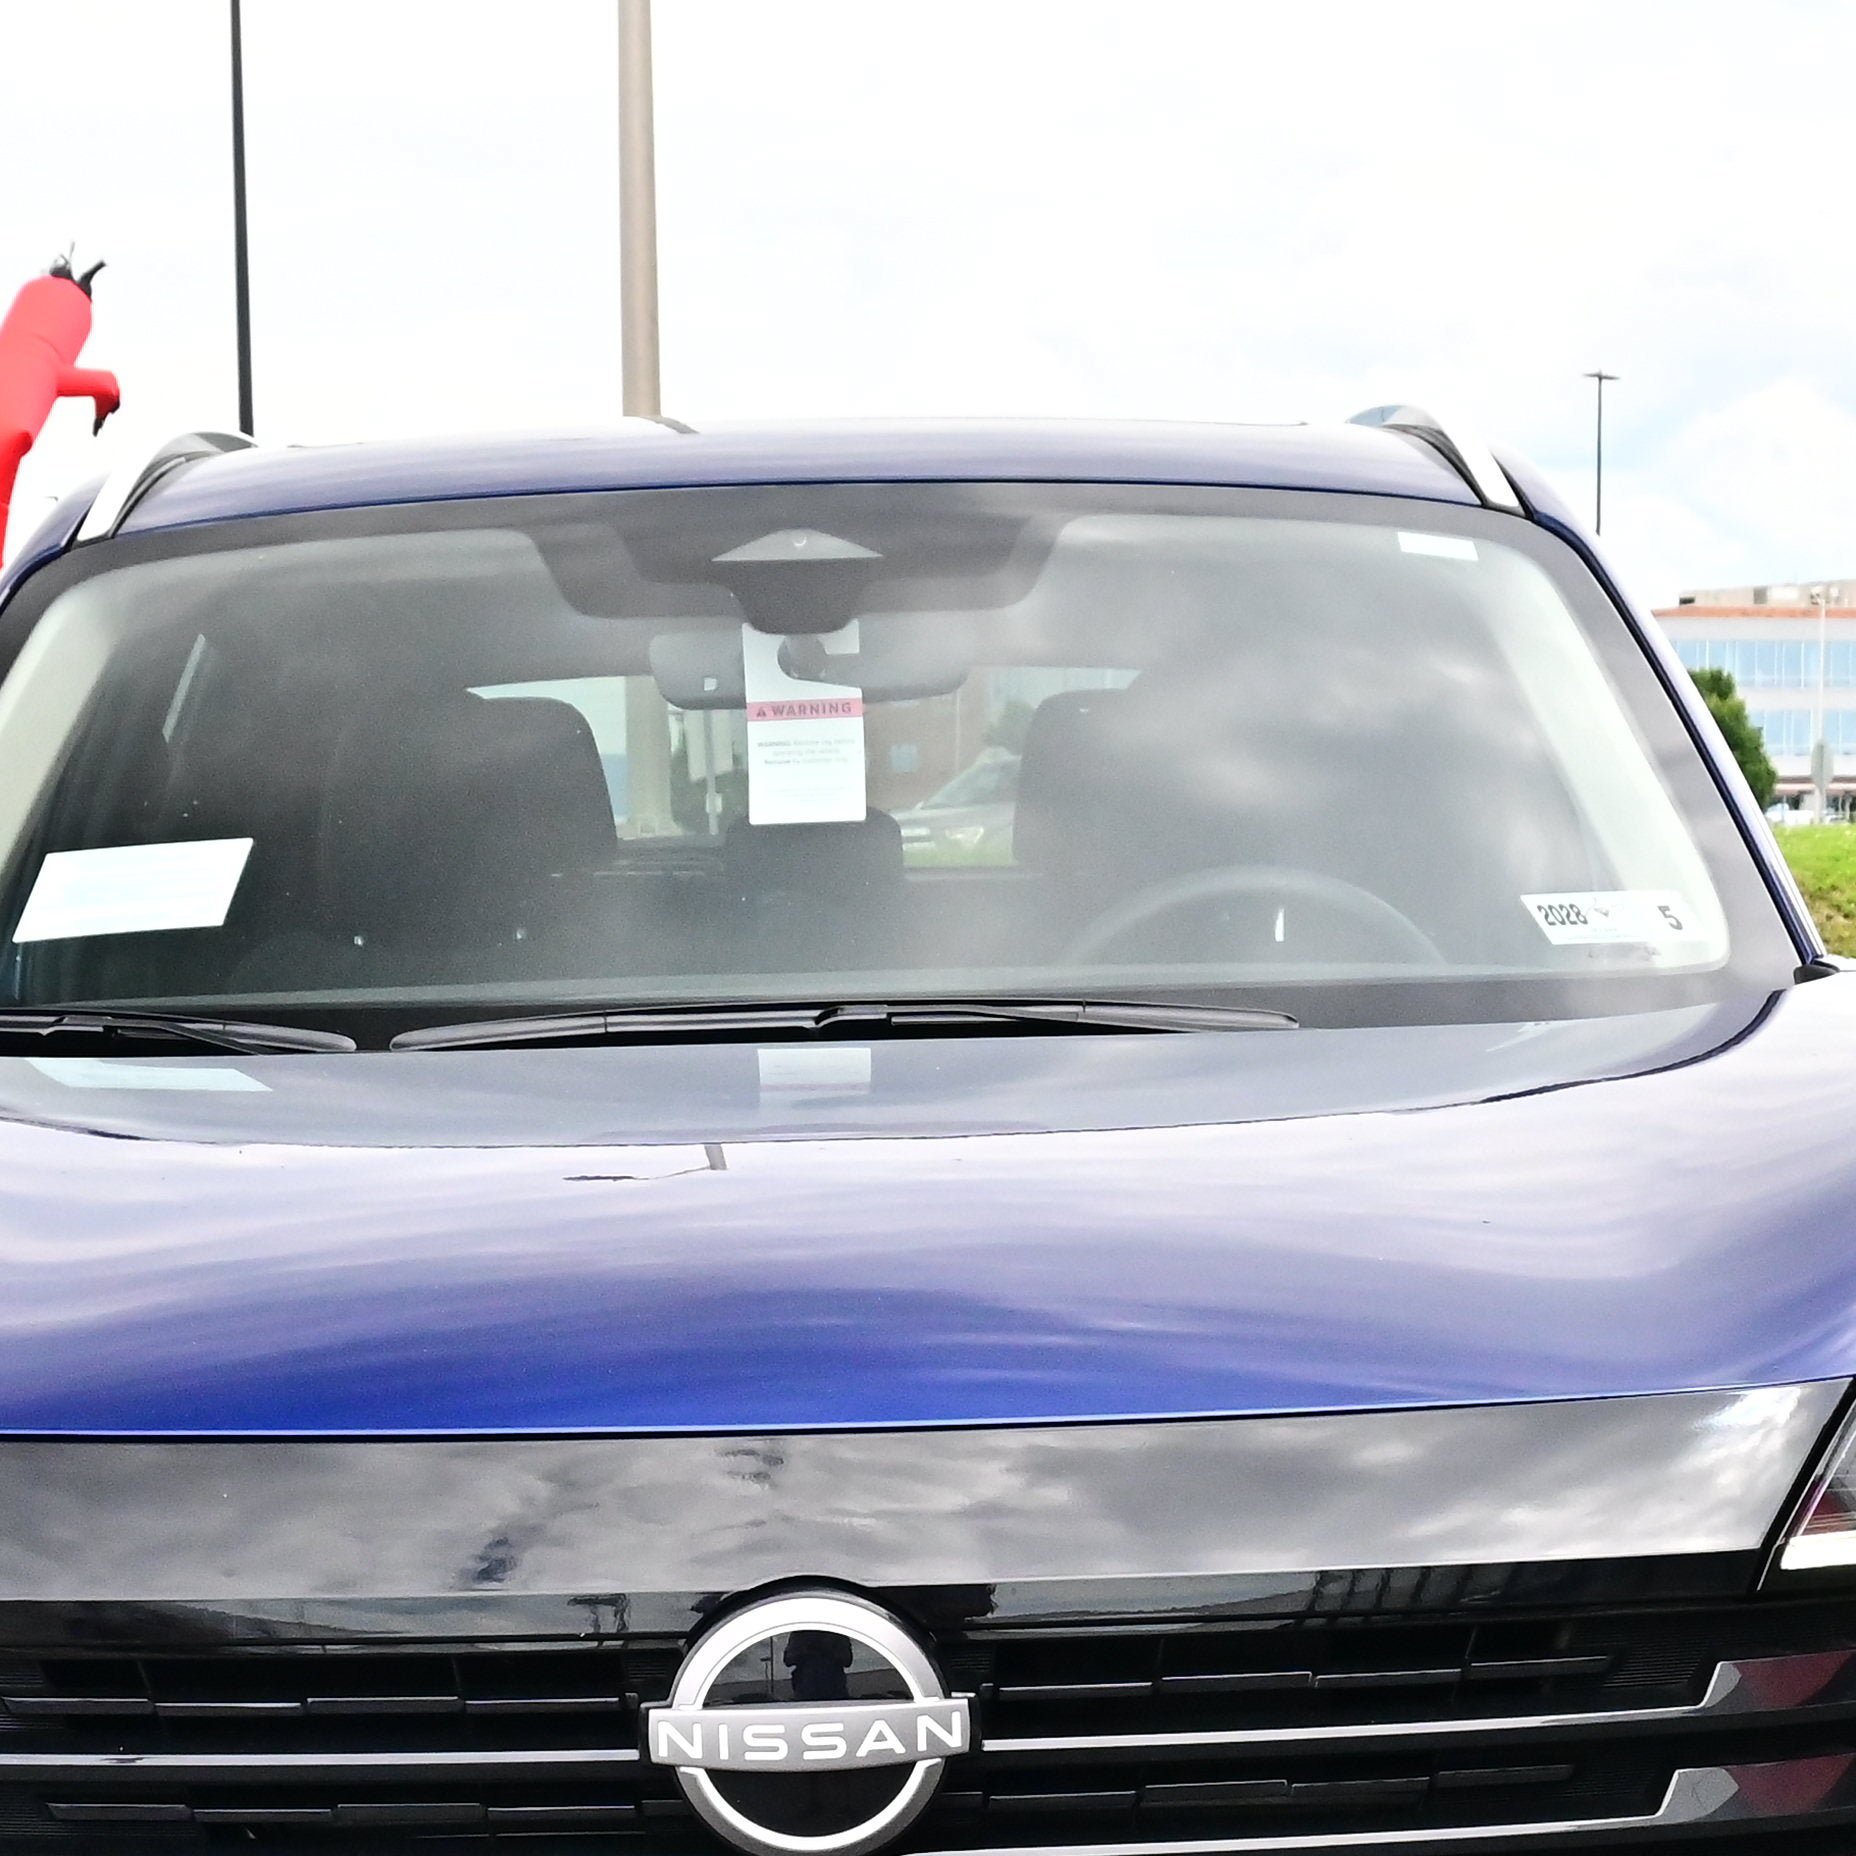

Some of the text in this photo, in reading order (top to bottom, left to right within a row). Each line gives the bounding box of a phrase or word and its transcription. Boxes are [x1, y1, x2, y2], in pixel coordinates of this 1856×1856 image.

[771, 702, 852, 717] WARNING
[1537, 903, 1683, 930] 2028 5
[657, 1710, 962, 1761] NISSAN
